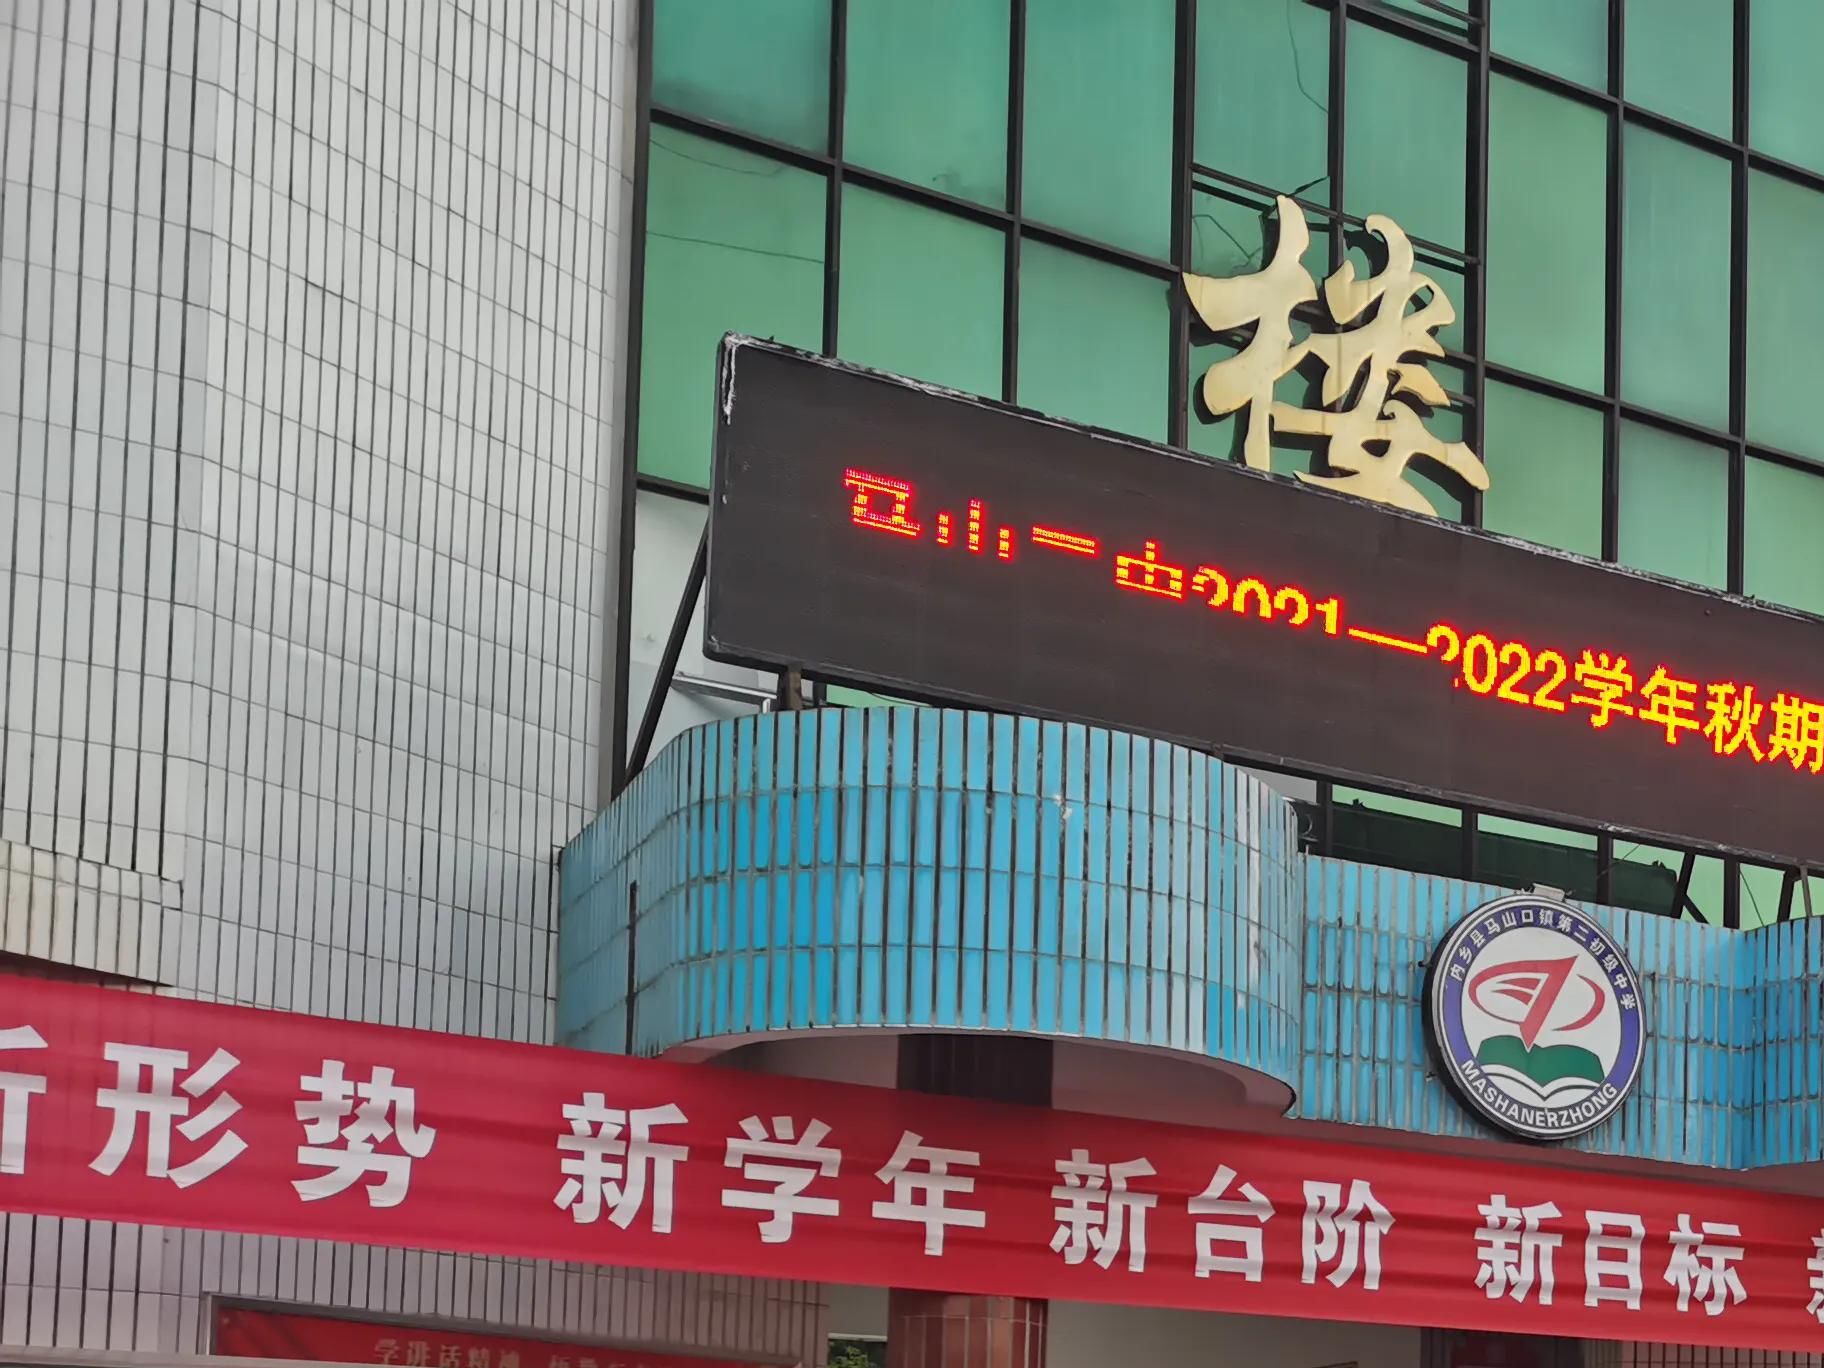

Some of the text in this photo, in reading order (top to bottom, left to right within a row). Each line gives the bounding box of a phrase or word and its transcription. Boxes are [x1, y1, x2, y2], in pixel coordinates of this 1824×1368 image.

[1182, 195, 1490, 517] 楼
[1450, 908, 1637, 1010] 内乡县马山口镇第二初级中学
[1461, 1059, 1618, 1128] MASHANERZHONG
[553, 1092, 986, 1257] 新学年
[1049, 1148, 1396, 1291] 新台阶
[1473, 1194, 1748, 1316] 新目标
